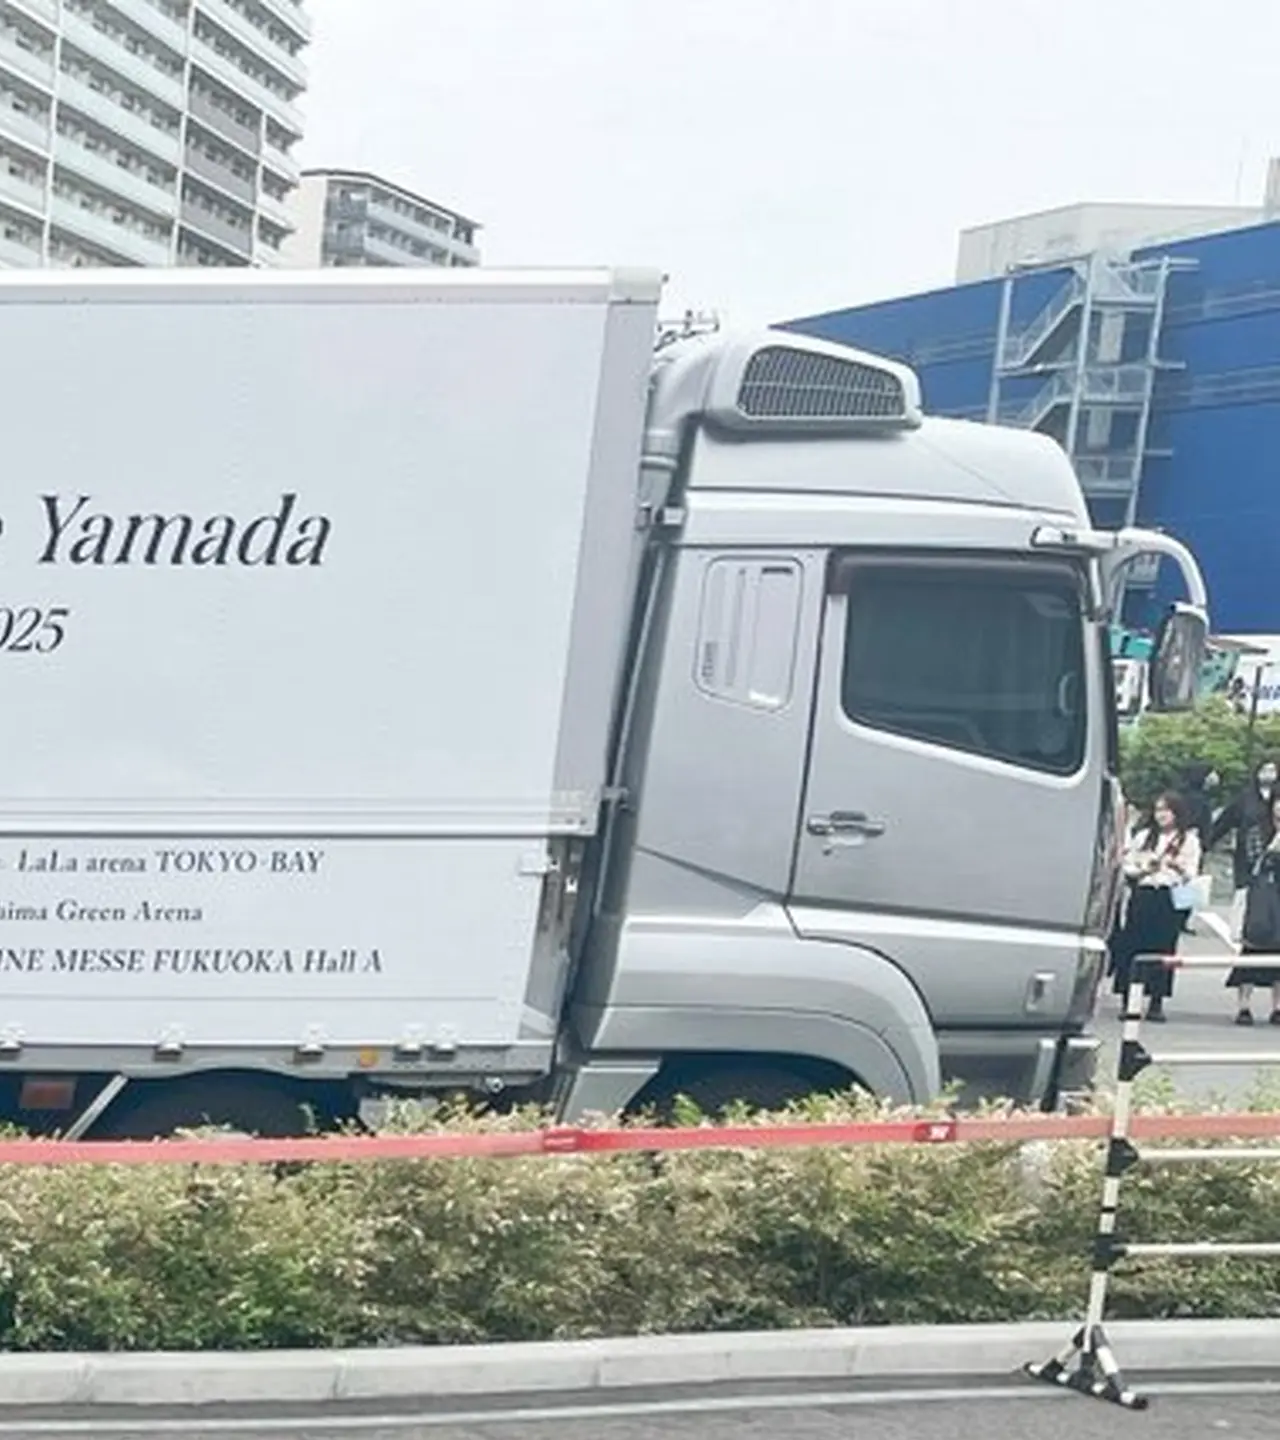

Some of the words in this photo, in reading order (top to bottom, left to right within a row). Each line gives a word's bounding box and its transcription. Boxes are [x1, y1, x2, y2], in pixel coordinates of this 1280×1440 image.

[37, 491, 332, 567] Yamada
[17, 848, 78, 873] LaLa
[85, 855, 148, 874] arena
[55, 898, 127, 923] Green
[132, 899, 203, 923] Arena
[52, 948, 146, 974] MESSE
[152, 948, 295, 975] FUKUOKA
[302, 948, 358, 974] Hall
[363, 949, 383, 974] A
